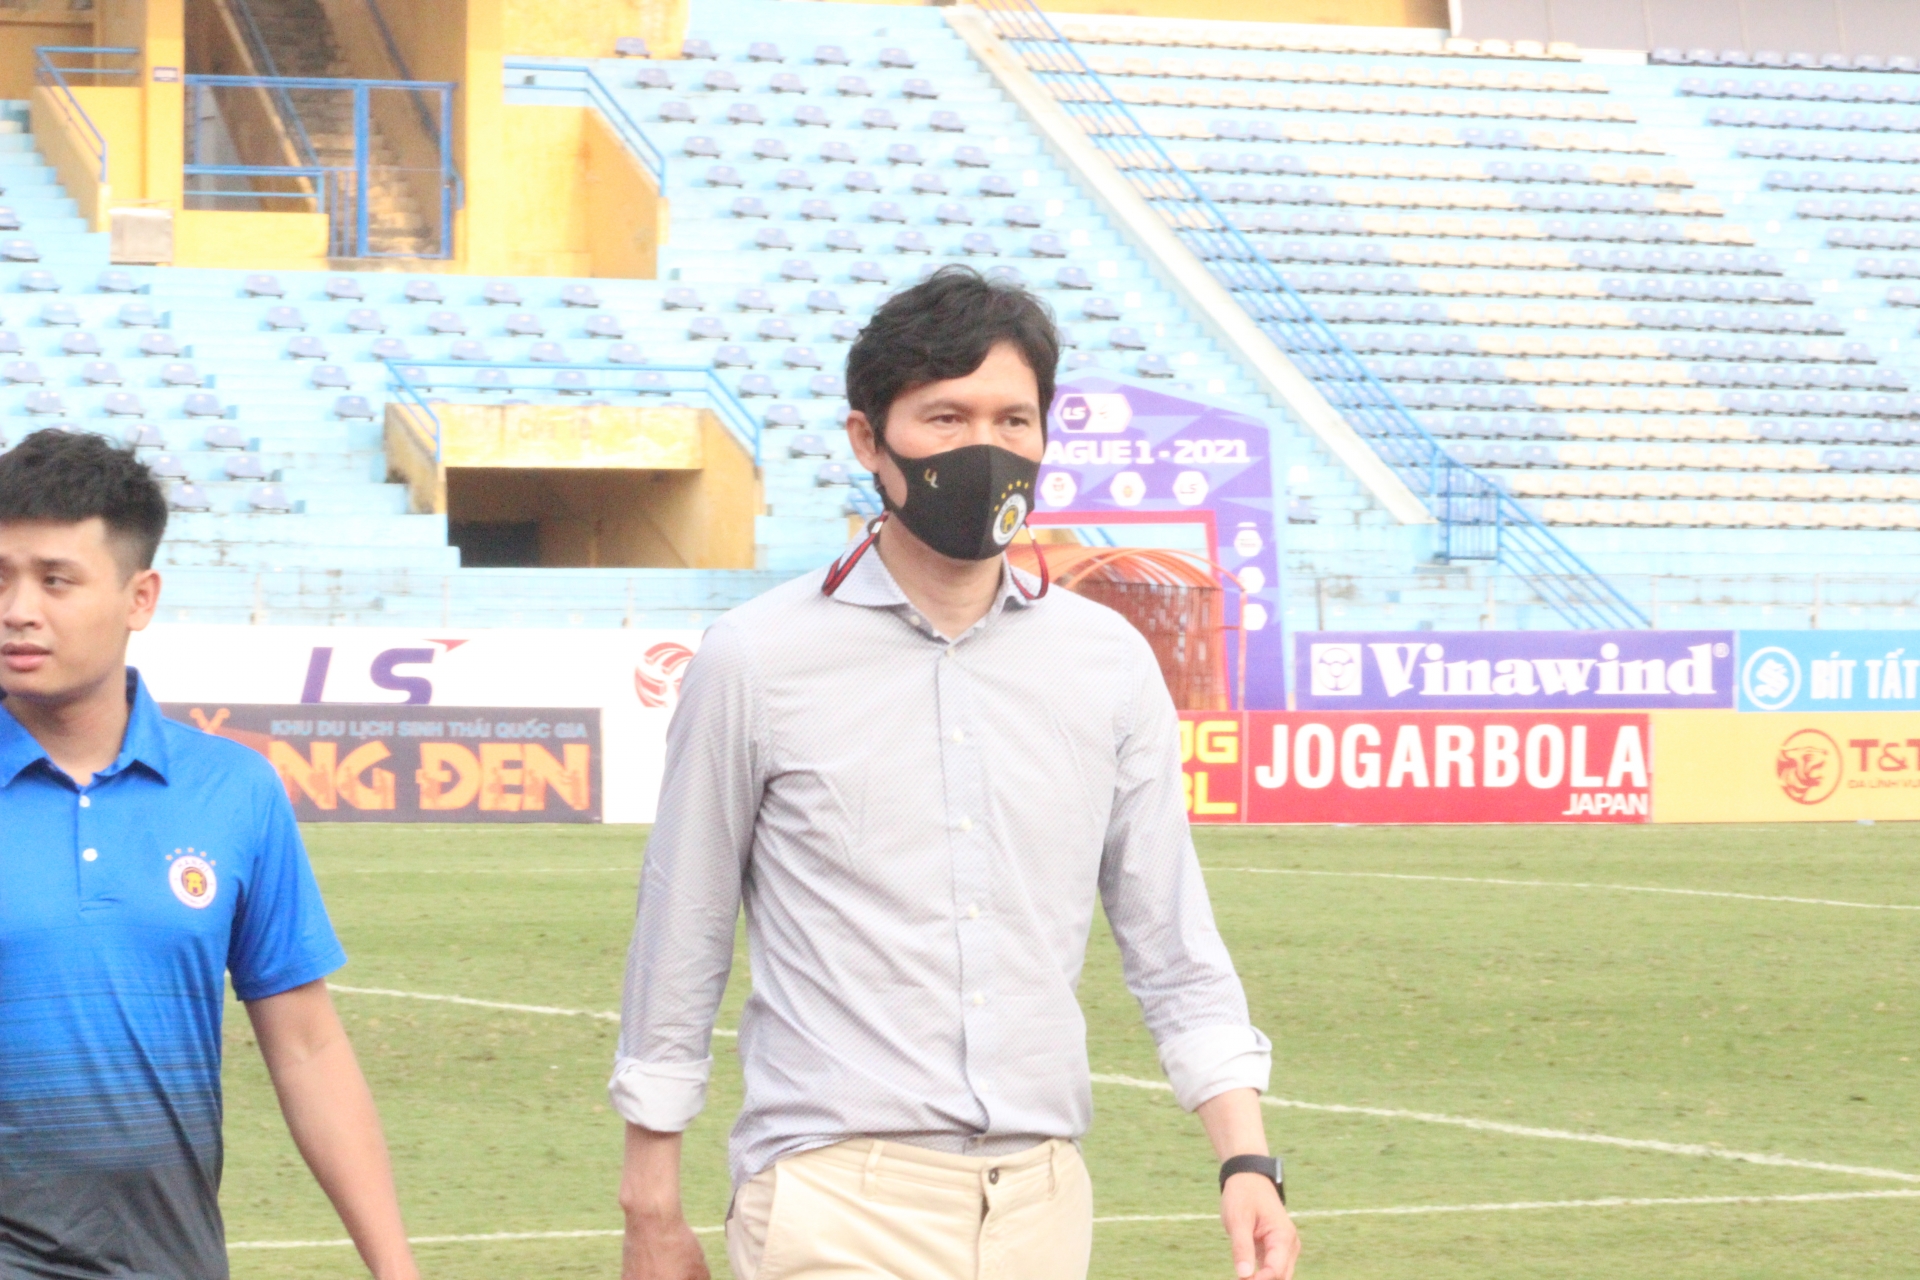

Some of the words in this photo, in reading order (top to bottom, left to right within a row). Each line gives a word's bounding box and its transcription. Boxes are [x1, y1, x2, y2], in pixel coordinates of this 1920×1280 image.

[1062, 406, 1087, 421] LS
[1041, 439, 1132, 466] AGUE
[301, 647, 436, 704] LS
[1809, 650, 1858, 700] BÍT
[1864, 647, 1920, 700] TẤT
[269, 720, 313, 737] KHU
[317, 720, 345, 738] DU
[348, 720, 394, 740] LỊCH
[397, 721, 443, 738] SINH
[447, 718, 490, 738] THÁI
[494, 718, 550, 740] QUỐC
[553, 722, 588, 739] GIA
[265, 740, 397, 811] NG
[415, 741, 591, 812] ĐEN
[1253, 722, 1648, 790] JOGARBOLA
[1561, 792, 1649, 817] JAPAN
